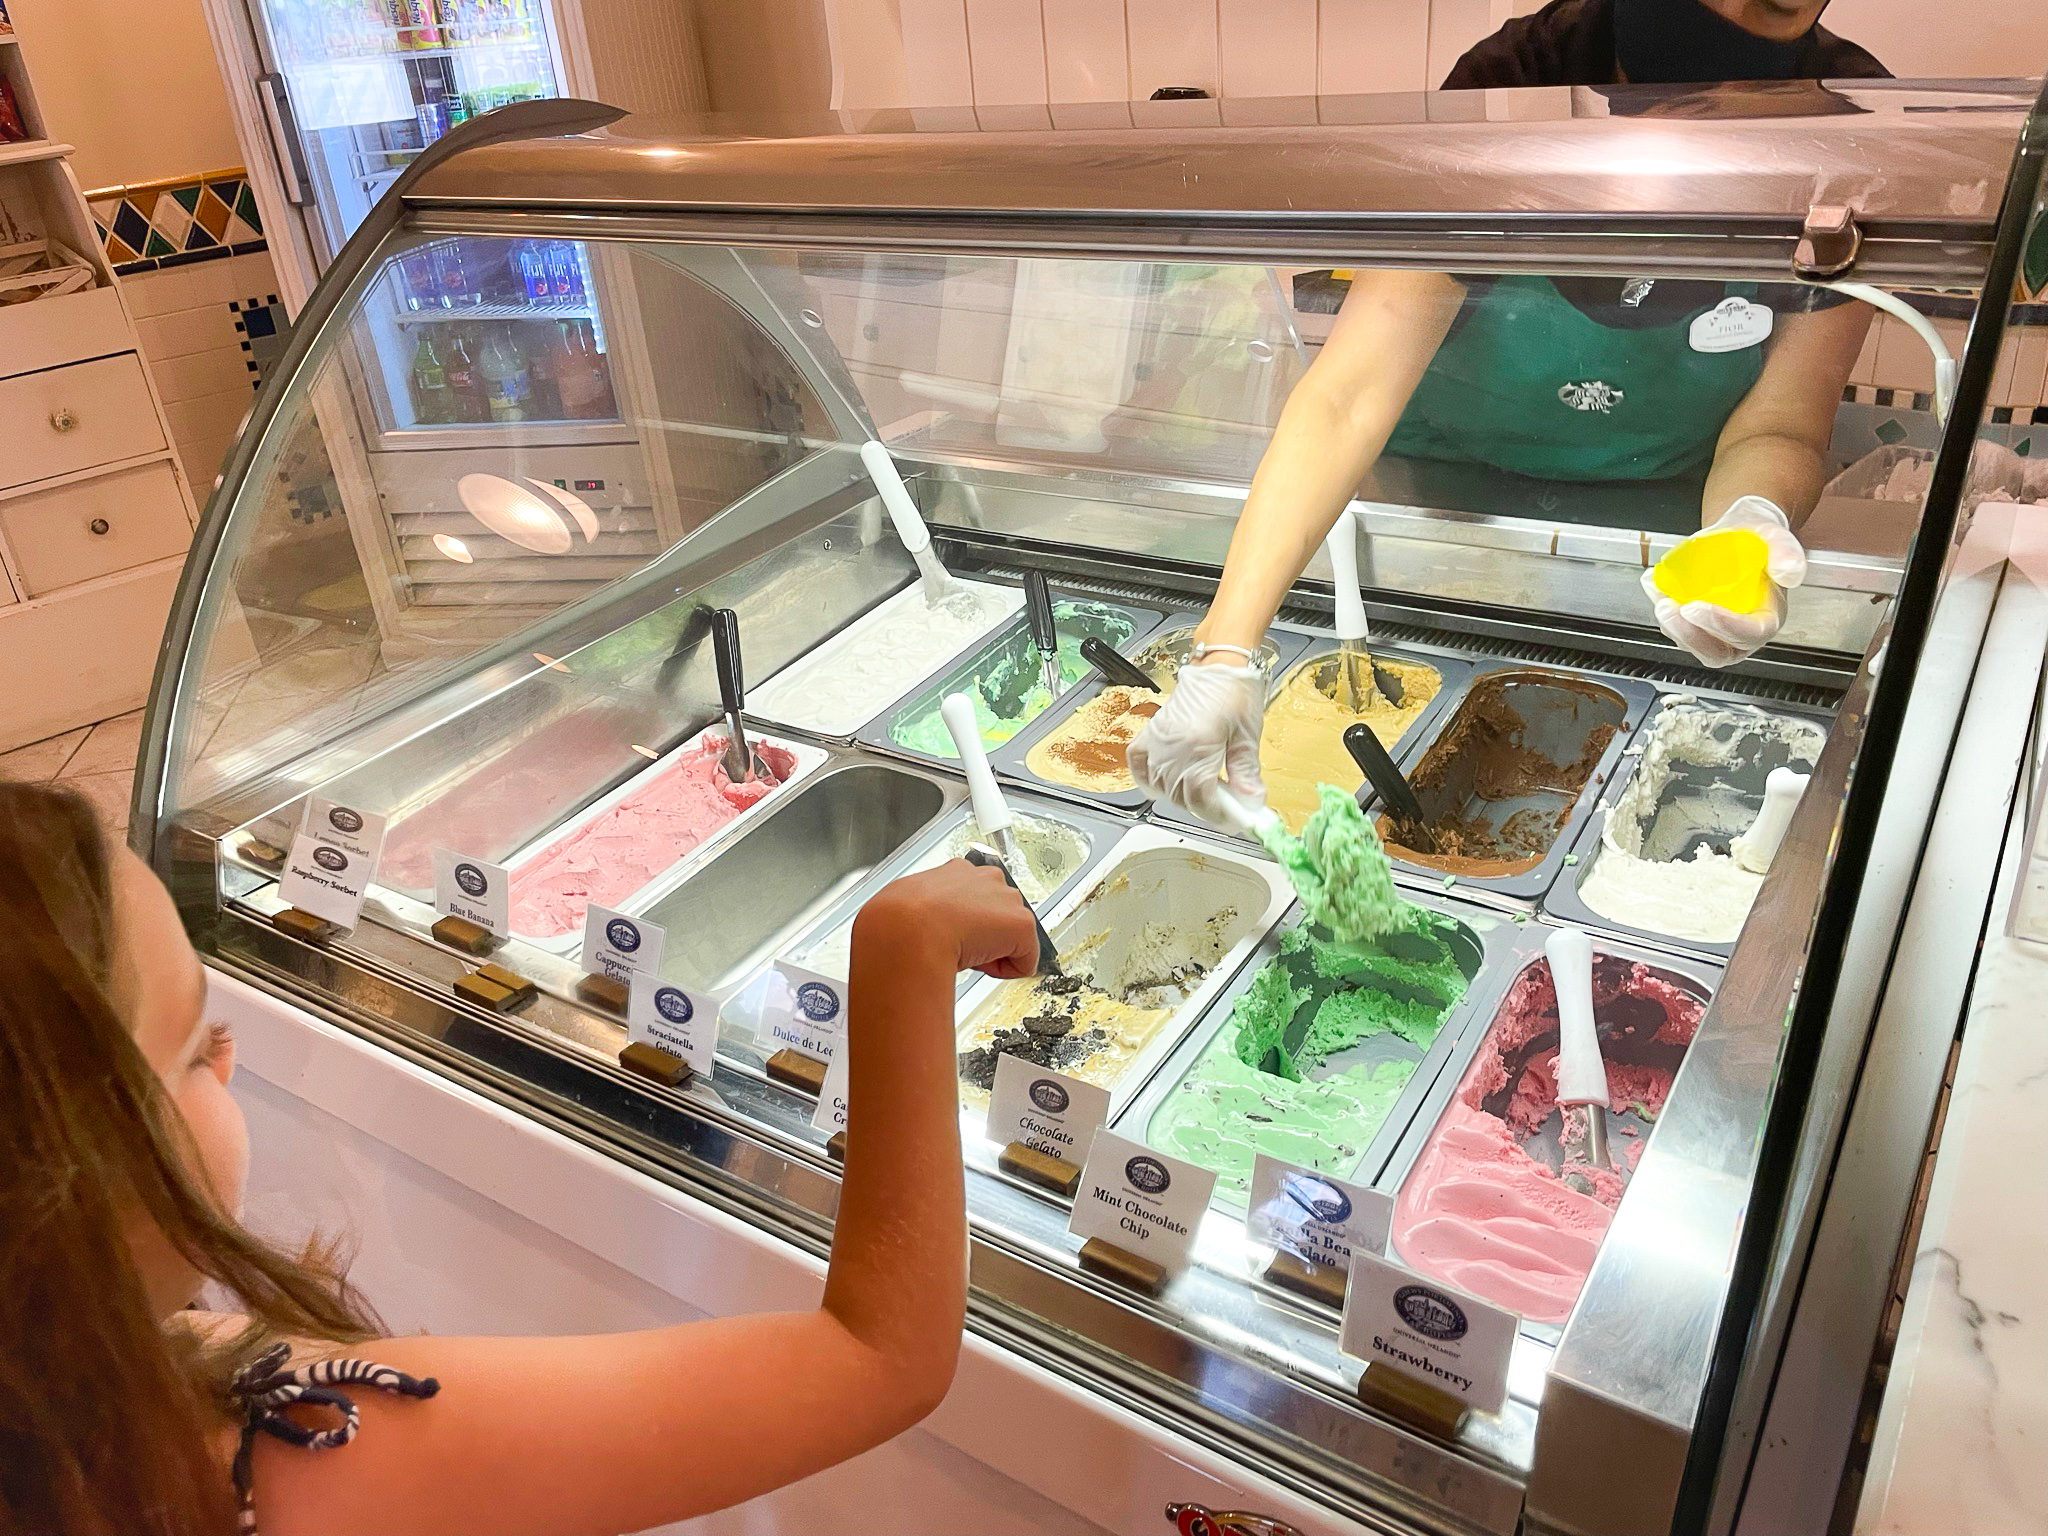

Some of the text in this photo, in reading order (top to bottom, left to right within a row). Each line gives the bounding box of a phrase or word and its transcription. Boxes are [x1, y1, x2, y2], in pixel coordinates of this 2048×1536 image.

[411, 0, 421, 24] Nesq
[342, 842, 370, 858] Sorbet
[330, 881, 357, 897] Sorbet
[450, 902, 494, 928] Blue Banana
[595, 951, 631, 973] Cappucc
[604, 968, 631, 986] Gelato
[646, 1024, 694, 1050] Straciatella
[772, 1026, 833, 1057] Dulce de Lec
[655, 1040, 682, 1059] Gelato
[1019, 1116, 1074, 1146] Chocolate
[1025, 1136, 1062, 1159] Gelato
[1092, 1185, 1188, 1236] Mint Chocolate
[1119, 1216, 1150, 1240] Chip
[1299, 1246, 1336, 1267] elato
[1323, 1235, 1351, 1257] Bea
[1372, 1335, 1473, 1391] Strawberry
